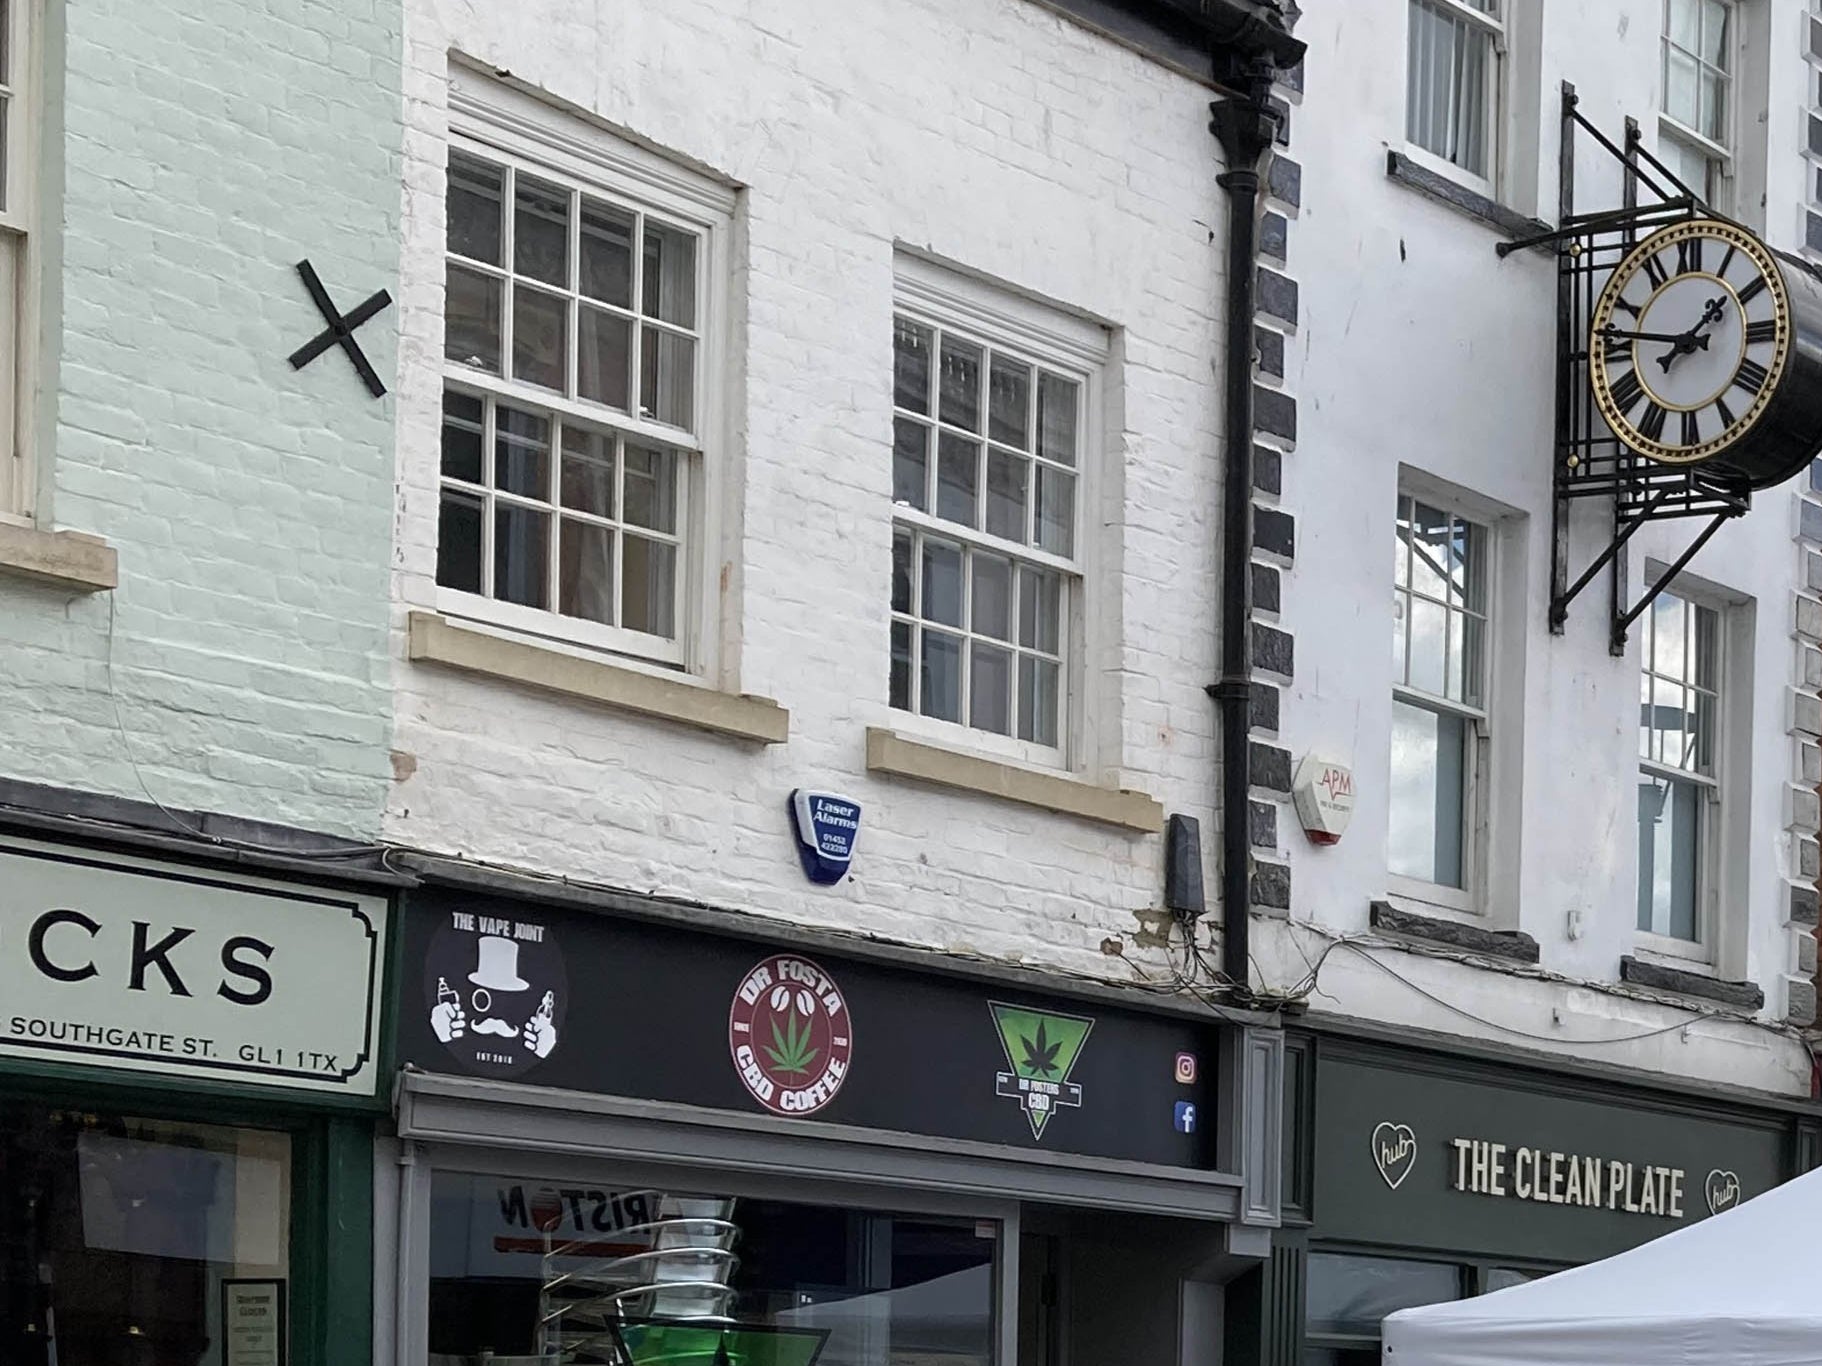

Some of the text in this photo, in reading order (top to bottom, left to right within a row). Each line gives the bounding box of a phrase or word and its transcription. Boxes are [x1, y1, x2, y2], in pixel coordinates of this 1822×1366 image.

[1321, 767, 1352, 797] APM
[813, 811, 857, 829] Alarms
[817, 799, 854, 817] Laser
[452, 911, 545, 943] THE VAPE JOINT
[28, 909, 275, 1006] CKS
[739, 959, 842, 1017] DR FOSTA
[10, 1016, 339, 1072] SOUTHGATE ST. GL1 1TX
[736, 1044, 847, 1111] CBD COFFEE
[1028, 1092, 1050, 1110] CBD
[1382, 1133, 1408, 1168] hub
[1452, 1137, 1686, 1218] THE CLEAN PLATE
[1712, 1178, 1734, 1209] hub
